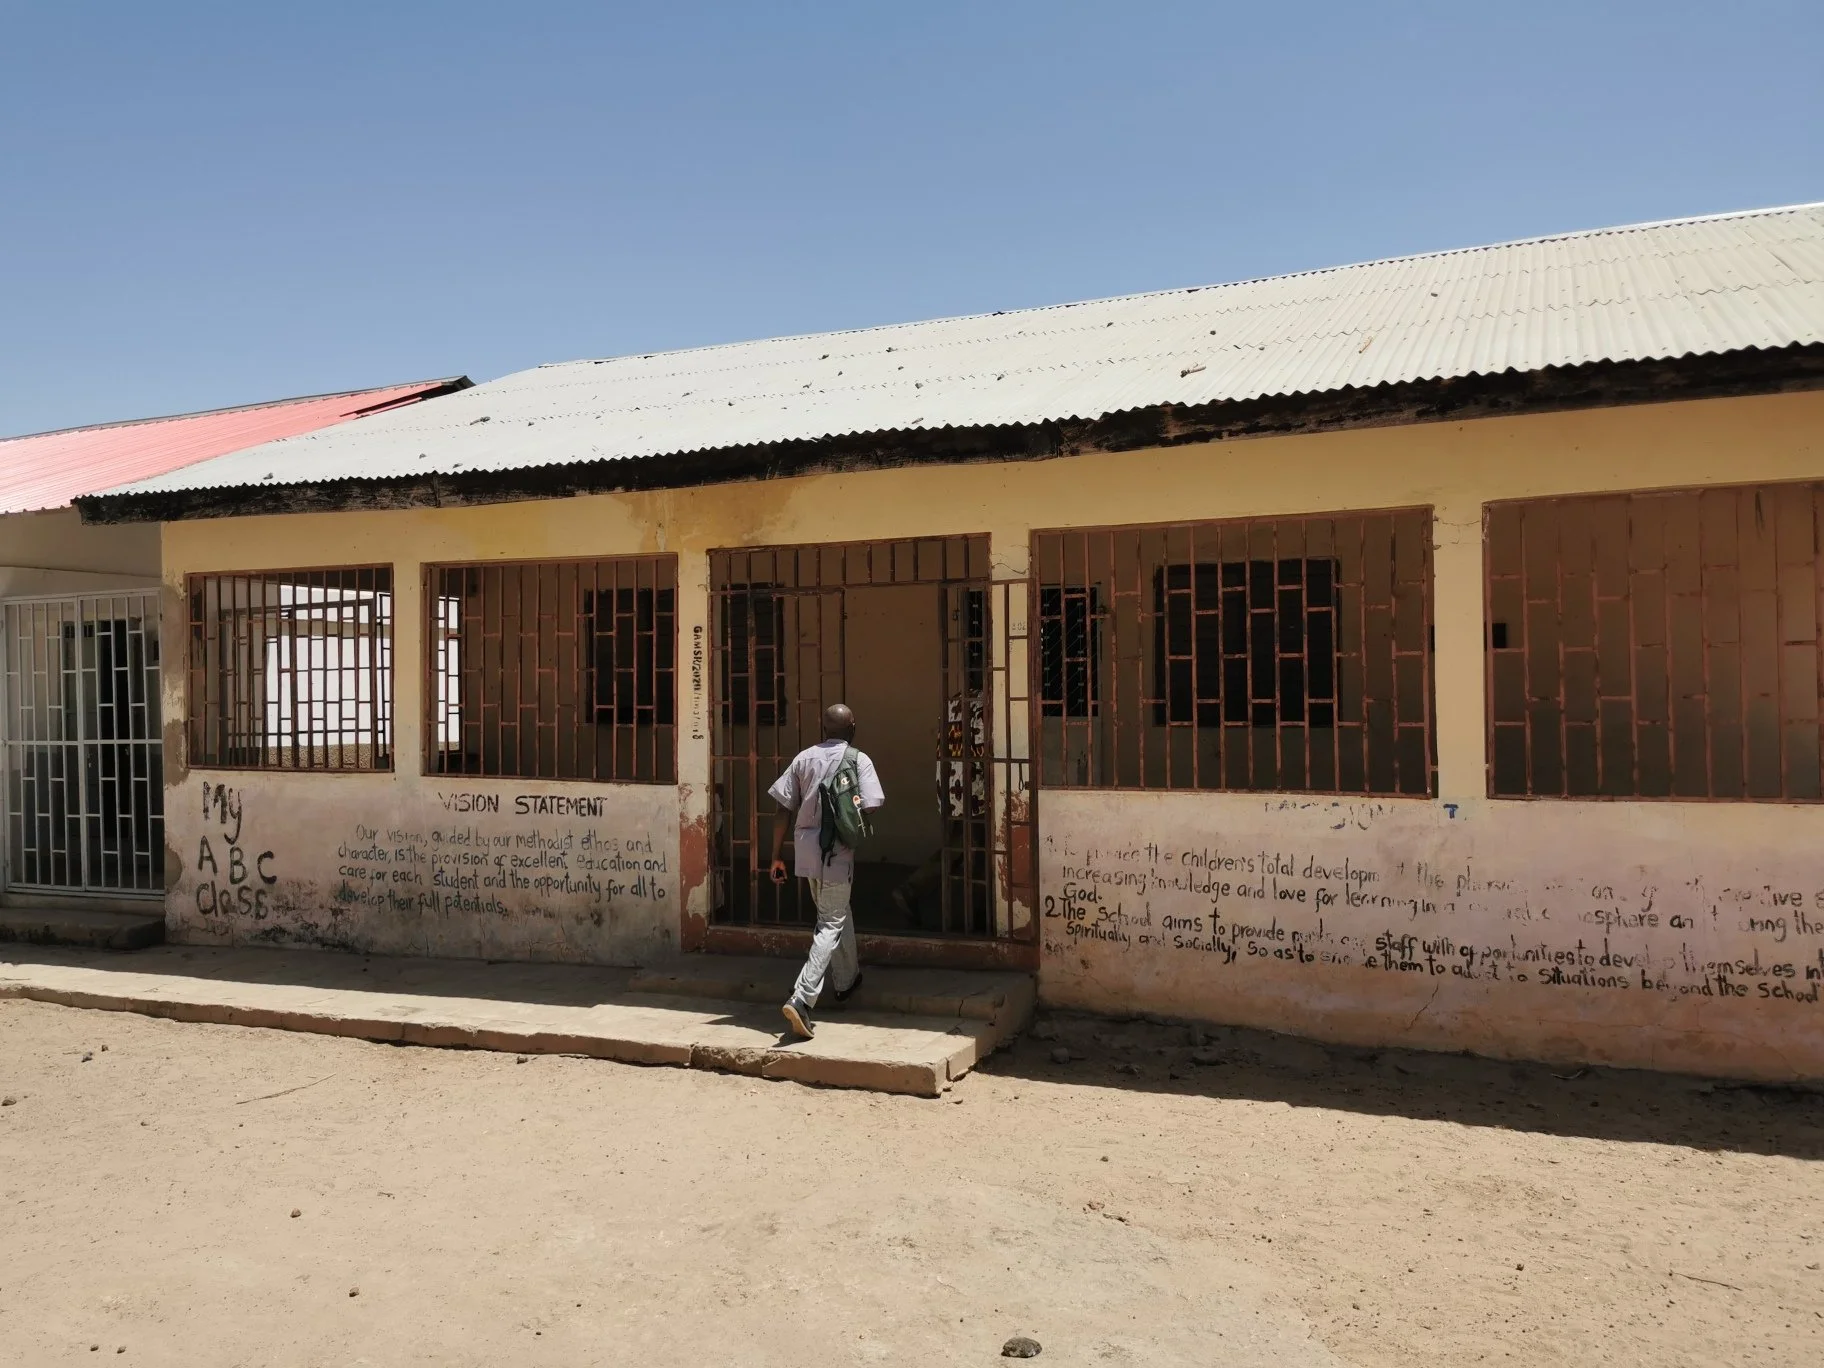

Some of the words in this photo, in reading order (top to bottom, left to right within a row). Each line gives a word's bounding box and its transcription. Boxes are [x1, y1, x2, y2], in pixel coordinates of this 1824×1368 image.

[203, 781, 243, 845] My
[437, 791, 500, 813] VISION
[514, 795, 608, 818] STATEMENT
[338, 841, 392, 865] character,
[394, 848, 406, 862] is
[407, 844, 427, 864] the
[431, 852, 489, 874] provision
[510, 849, 569, 870] excellent
[576, 851, 640, 873] education
[643, 851, 668, 873] and
[355, 823, 379, 842] Our
[431, 826, 471, 851] guided
[475, 826, 491, 857] by
[493, 835, 511, 848] our
[516, 828, 573, 851] methodist
[580, 829, 619, 851] ethos
[626, 832, 654, 854] and
[197, 835, 218, 877] A
[229, 846, 248, 885] B
[256, 850, 278, 885] C
[1257, 851, 1295, 877] total
[338, 864, 367, 880] care
[369, 869, 388, 888] for
[392, 864, 423, 886] each
[433, 866, 480, 890] student
[483, 868, 507, 889] and
[508, 868, 530, 889] the
[533, 871, 601, 904] opportunity
[605, 879, 626, 902] for
[630, 874, 647, 898] all
[650, 876, 666, 900] to
[387, 889, 414, 913] their
[417, 889, 441, 916] full
[1062, 882, 1104, 903] God.
[1236, 876, 1265, 899] and
[1273, 877, 1307, 903] love
[1315, 888, 1339, 913] for
[1793, 909, 1824, 936] the
[1161, 914, 1203, 933] aims
[1208, 907, 1226, 936] to
[1231, 915, 1286, 945] provide
[1422, 935, 1455, 957] with
[1273, 949, 1295, 961] as
[1298, 943, 1316, 964] to
[1380, 950, 1424, 972] them
[1424, 954, 1447, 976] to
[1712, 973, 1750, 998] the
